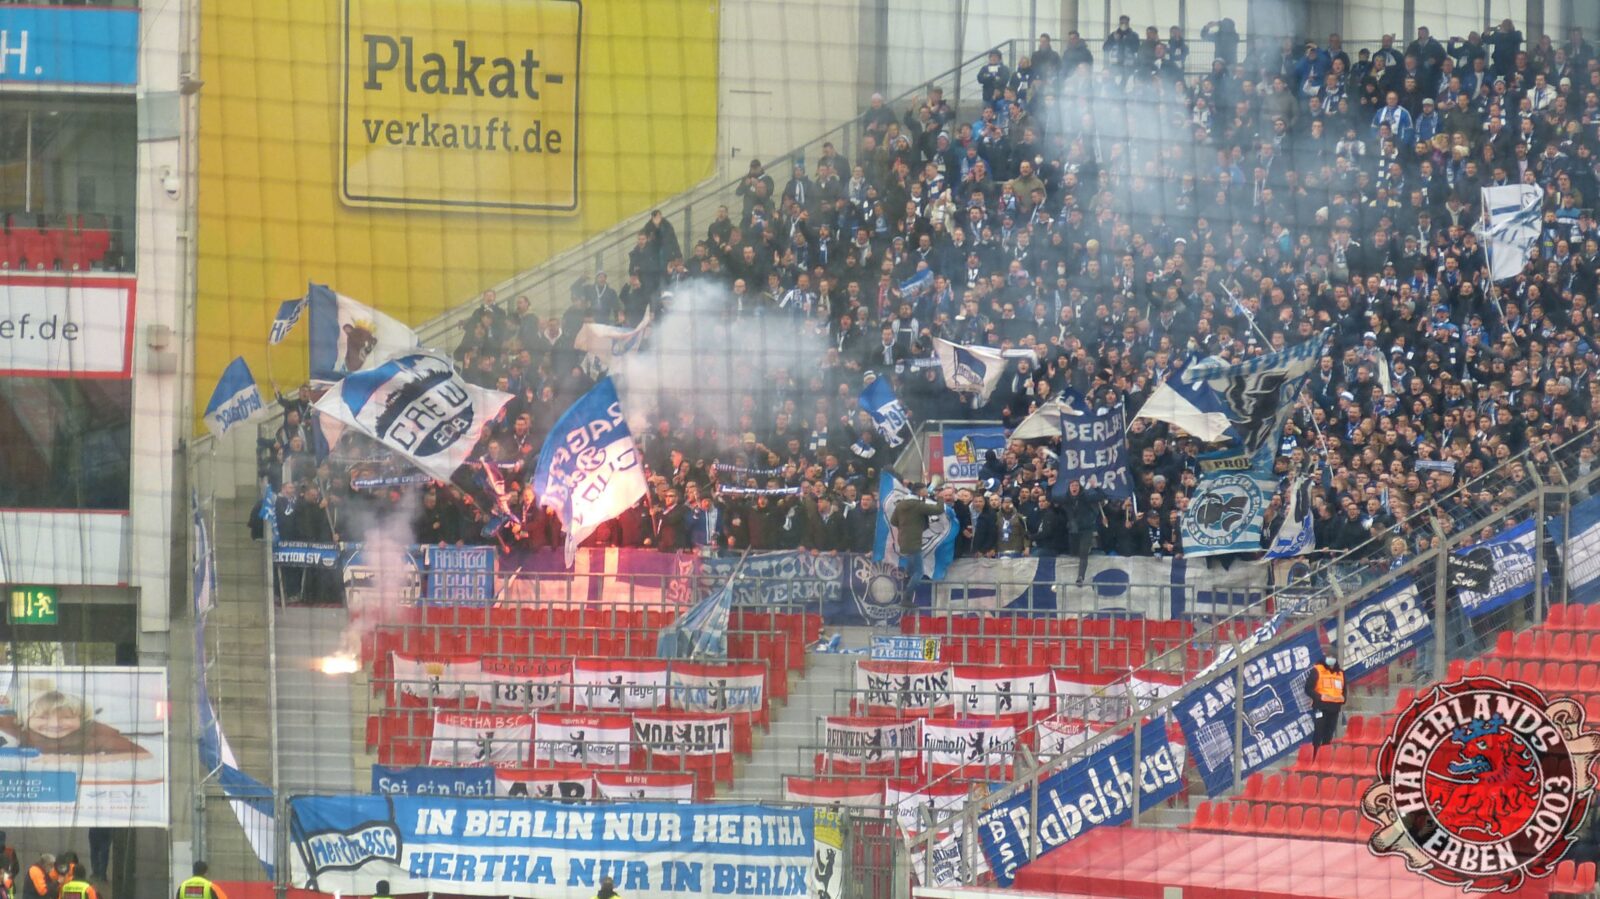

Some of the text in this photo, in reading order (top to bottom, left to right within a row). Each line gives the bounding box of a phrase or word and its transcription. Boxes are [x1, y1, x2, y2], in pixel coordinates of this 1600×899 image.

[363, 34, 564, 100] Plakat-
[362, 113, 563, 154] verkauft.de
[1189, 676, 1236, 728] FAN
[1243, 645, 1311, 687] CLUB
[445, 716, 491, 728] HERTHA
[379, 778, 407, 797] Sei
[416, 779, 450, 796] ein
[362, 827, 396, 856] BSC
[415, 808, 806, 847] IN BERLIN NUR HERTHA
[409, 852, 807, 897] HERTHA NUR IN BERLIN
